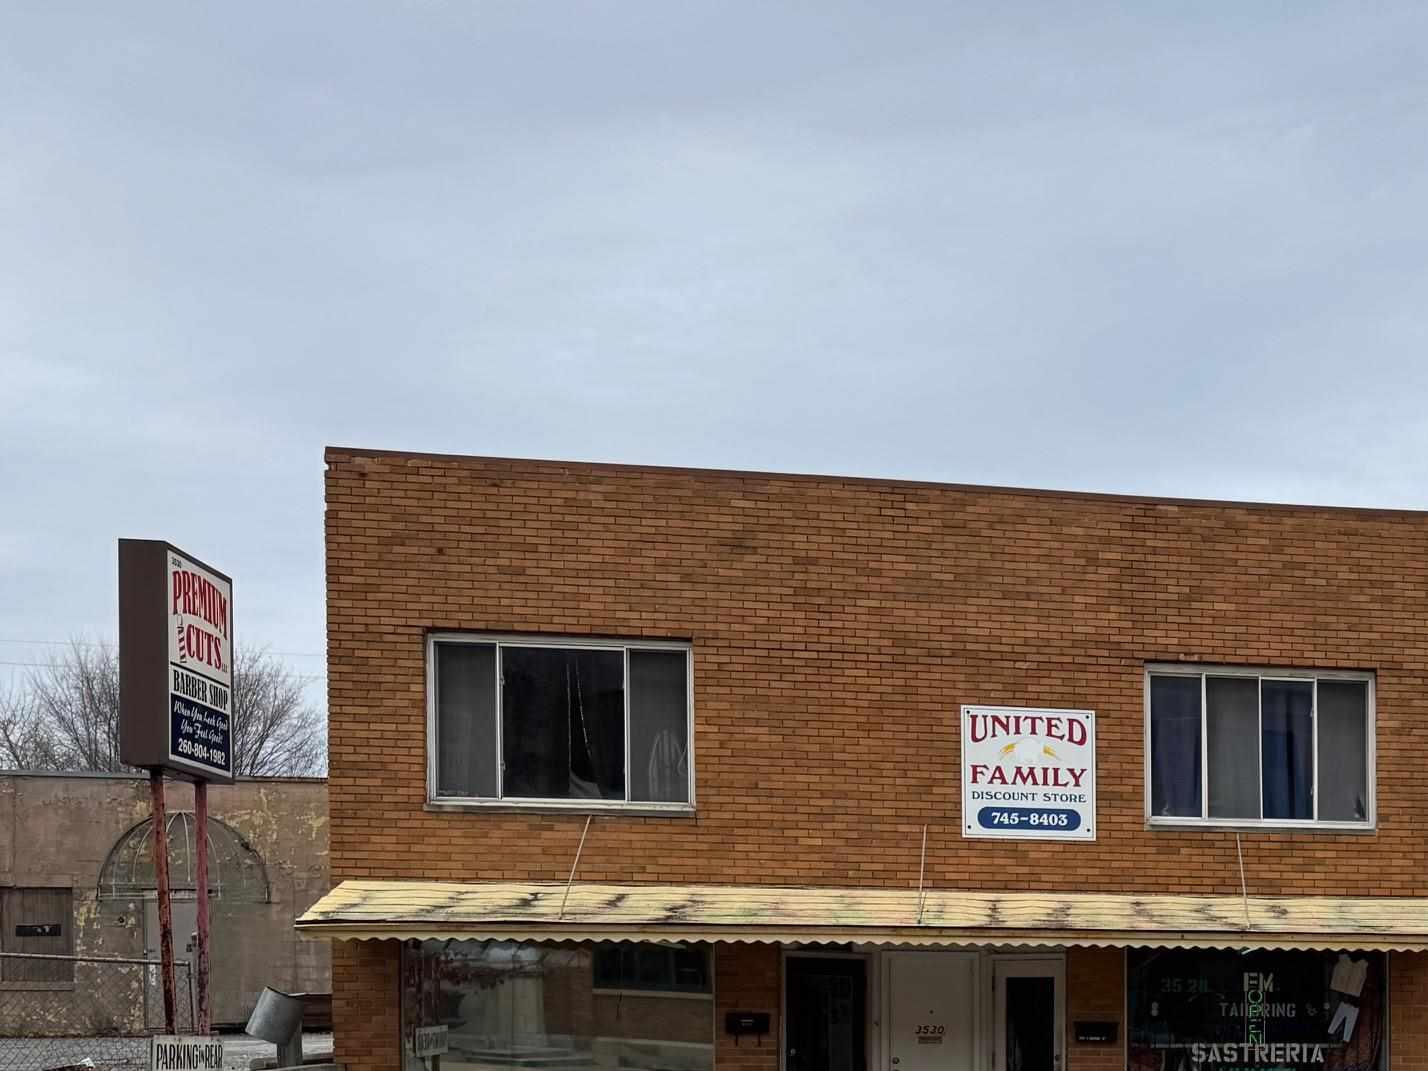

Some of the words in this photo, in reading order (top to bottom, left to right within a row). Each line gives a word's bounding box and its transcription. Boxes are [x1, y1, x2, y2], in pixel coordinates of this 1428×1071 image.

[172, 570, 228, 641] PREMIUM
[186, 623, 223, 671] CUTS
[173, 669, 208, 703] BARBER
[209, 685, 229, 712] SHOP
[174, 700, 190, 716] When
[191, 707, 202, 722] You
[180, 719, 193, 734] You
[969, 714, 1087, 746] UNITED
[178, 738, 226, 765] 260-804-1982
[970, 764, 1087, 787] FAMILY
[972, 790, 1038, 801] DISCOUNT
[1043, 792, 1087, 803] STORE
[991, 812, 1068, 826] 745-8403
[156, 1043, 199, 1070] PARKING
[205, 1044, 223, 1069] REAR
[1191, 1043, 1325, 1063] SASTRERIA
